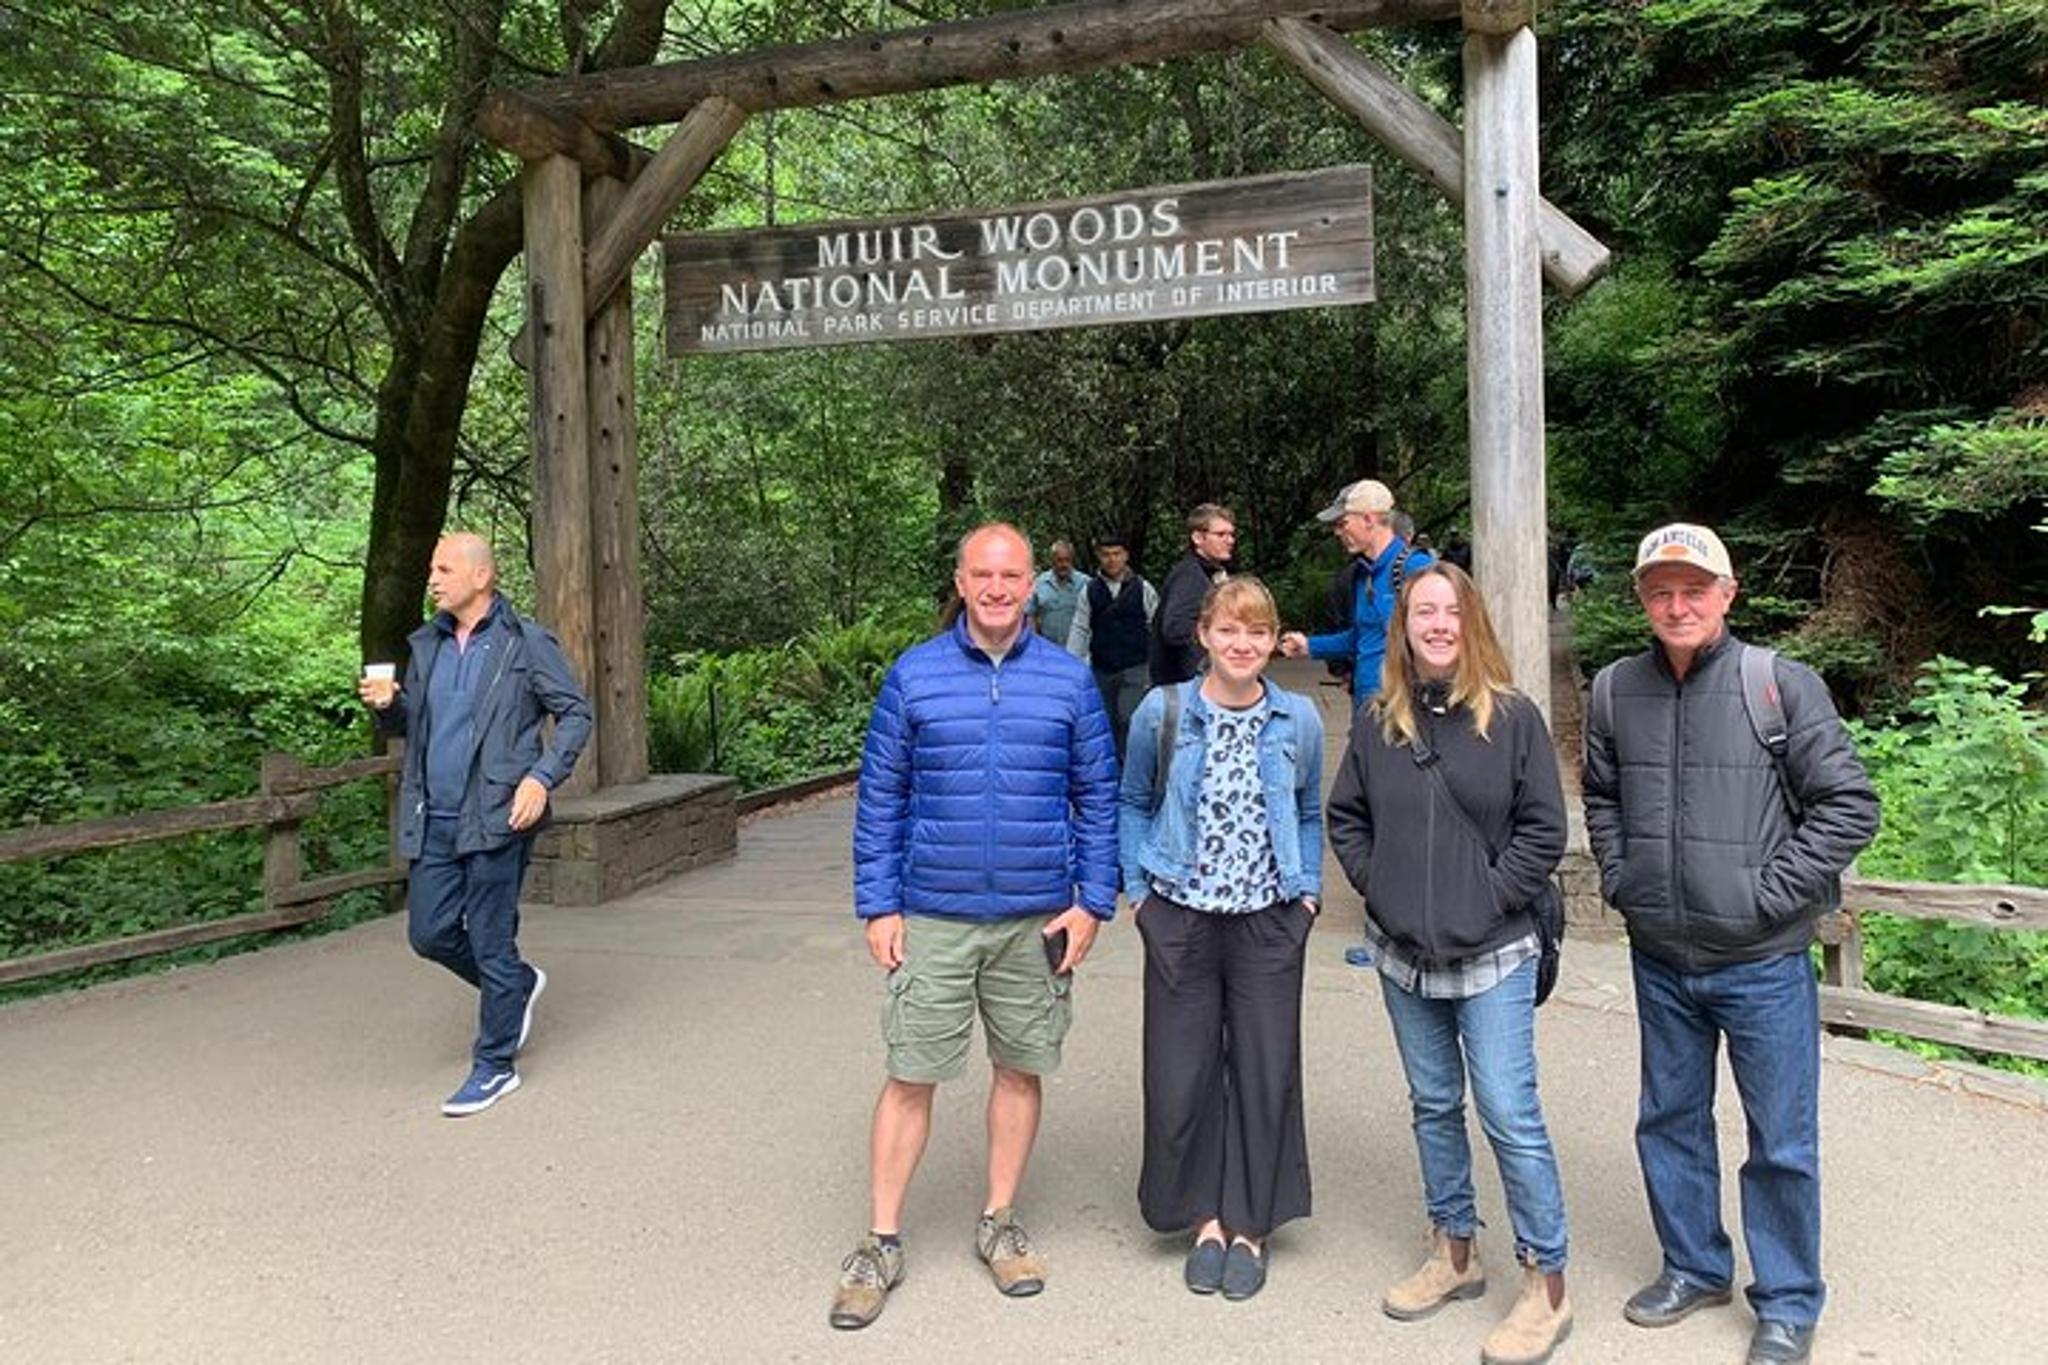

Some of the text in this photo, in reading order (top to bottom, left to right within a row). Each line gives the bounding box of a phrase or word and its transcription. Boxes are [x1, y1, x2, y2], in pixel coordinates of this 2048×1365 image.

[818, 199, 1181, 268] MUIR WOODS
[701, 273, 1337, 342] NATIONAL PARK SERVICE DEPARTMENT OF INTERIOR
[721, 231, 1298, 317] NATIONAL MONUMENT
